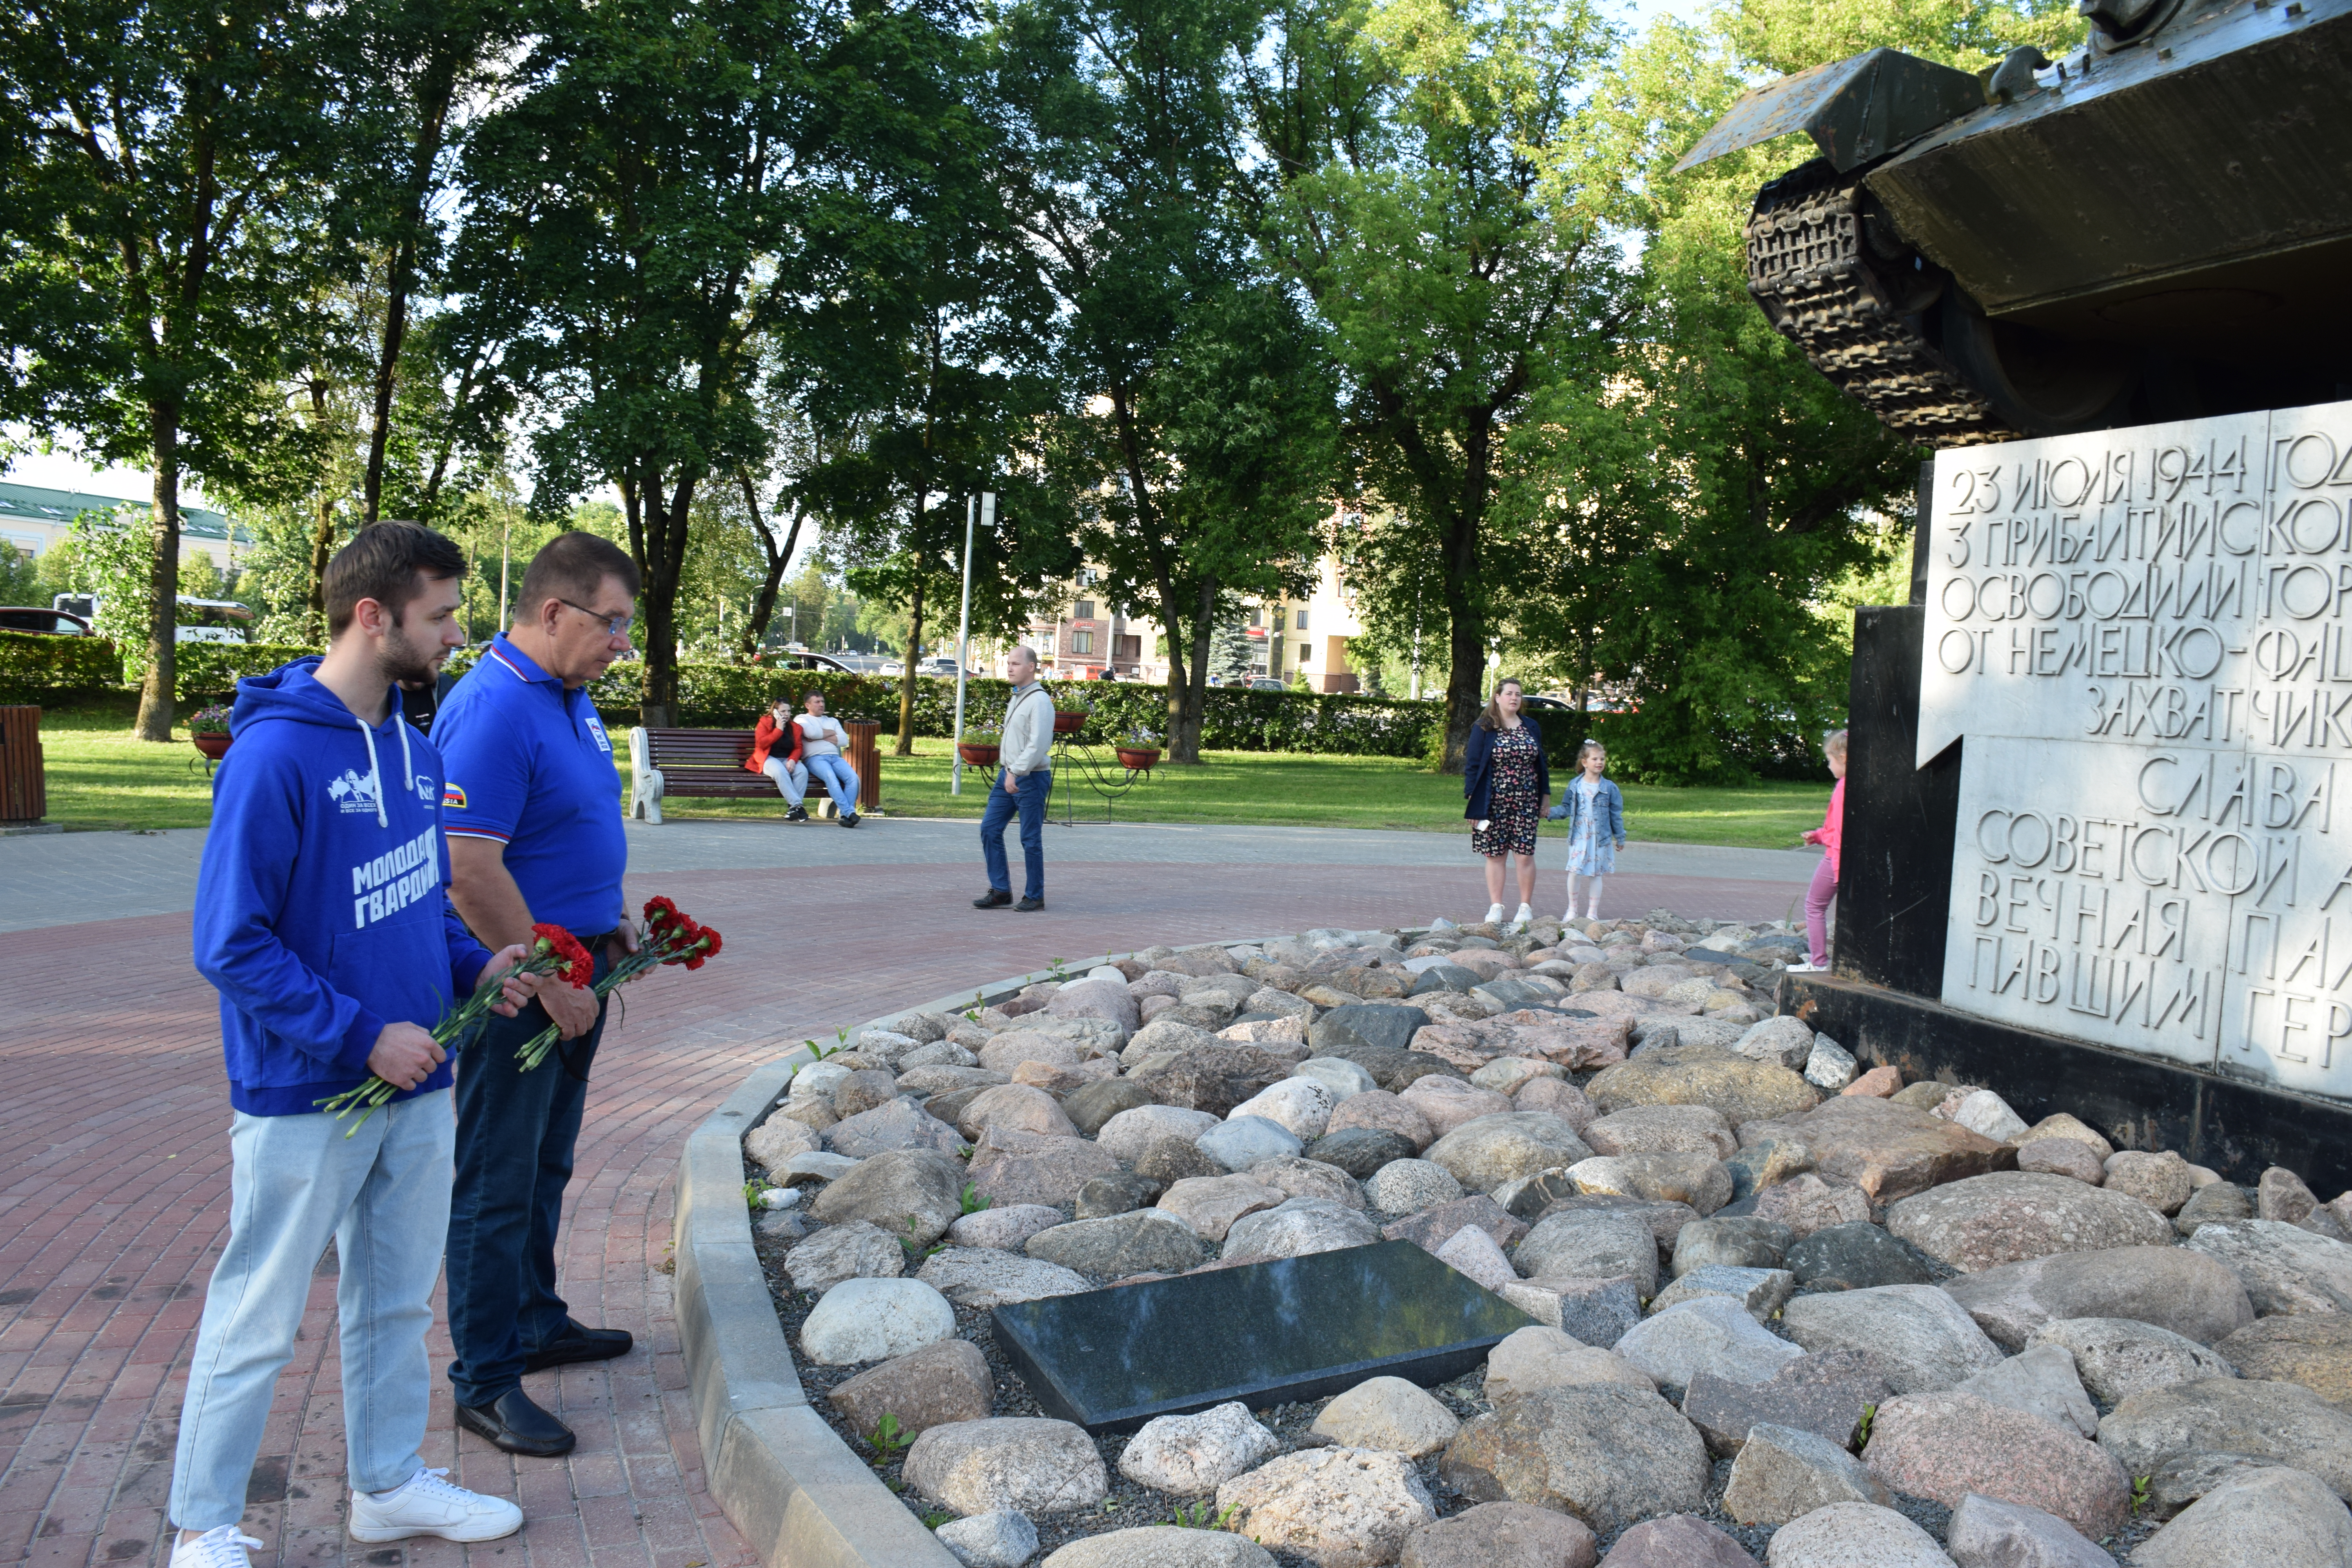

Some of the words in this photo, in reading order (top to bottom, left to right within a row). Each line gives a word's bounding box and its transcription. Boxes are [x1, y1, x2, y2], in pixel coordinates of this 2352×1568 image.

[1947, 465, 2002, 515] 23
[2012, 450, 2134, 513] ИЮЛЯ
[2146, 435, 2247, 501] 1944
[1945, 521, 1971, 568] 3
[1942, 561, 2245, 621] ОСВОБОДИЛИ
[1938, 627, 1993, 674] ОТ
[2085, 681, 2352, 748] ЗАХВАТЧИК
[2138, 753, 2334, 833] СЛАВА
[352, 824, 439, 895] МОЛОДАЯ
[1976, 807, 2301, 907] СОВЕТСКОЙ
[1973, 869, 2189, 962] ВЕЧНАЯ
[1968, 933, 2209, 1039] ПАВШИМ
[2239, 985, 2352, 1068] ГЕР
